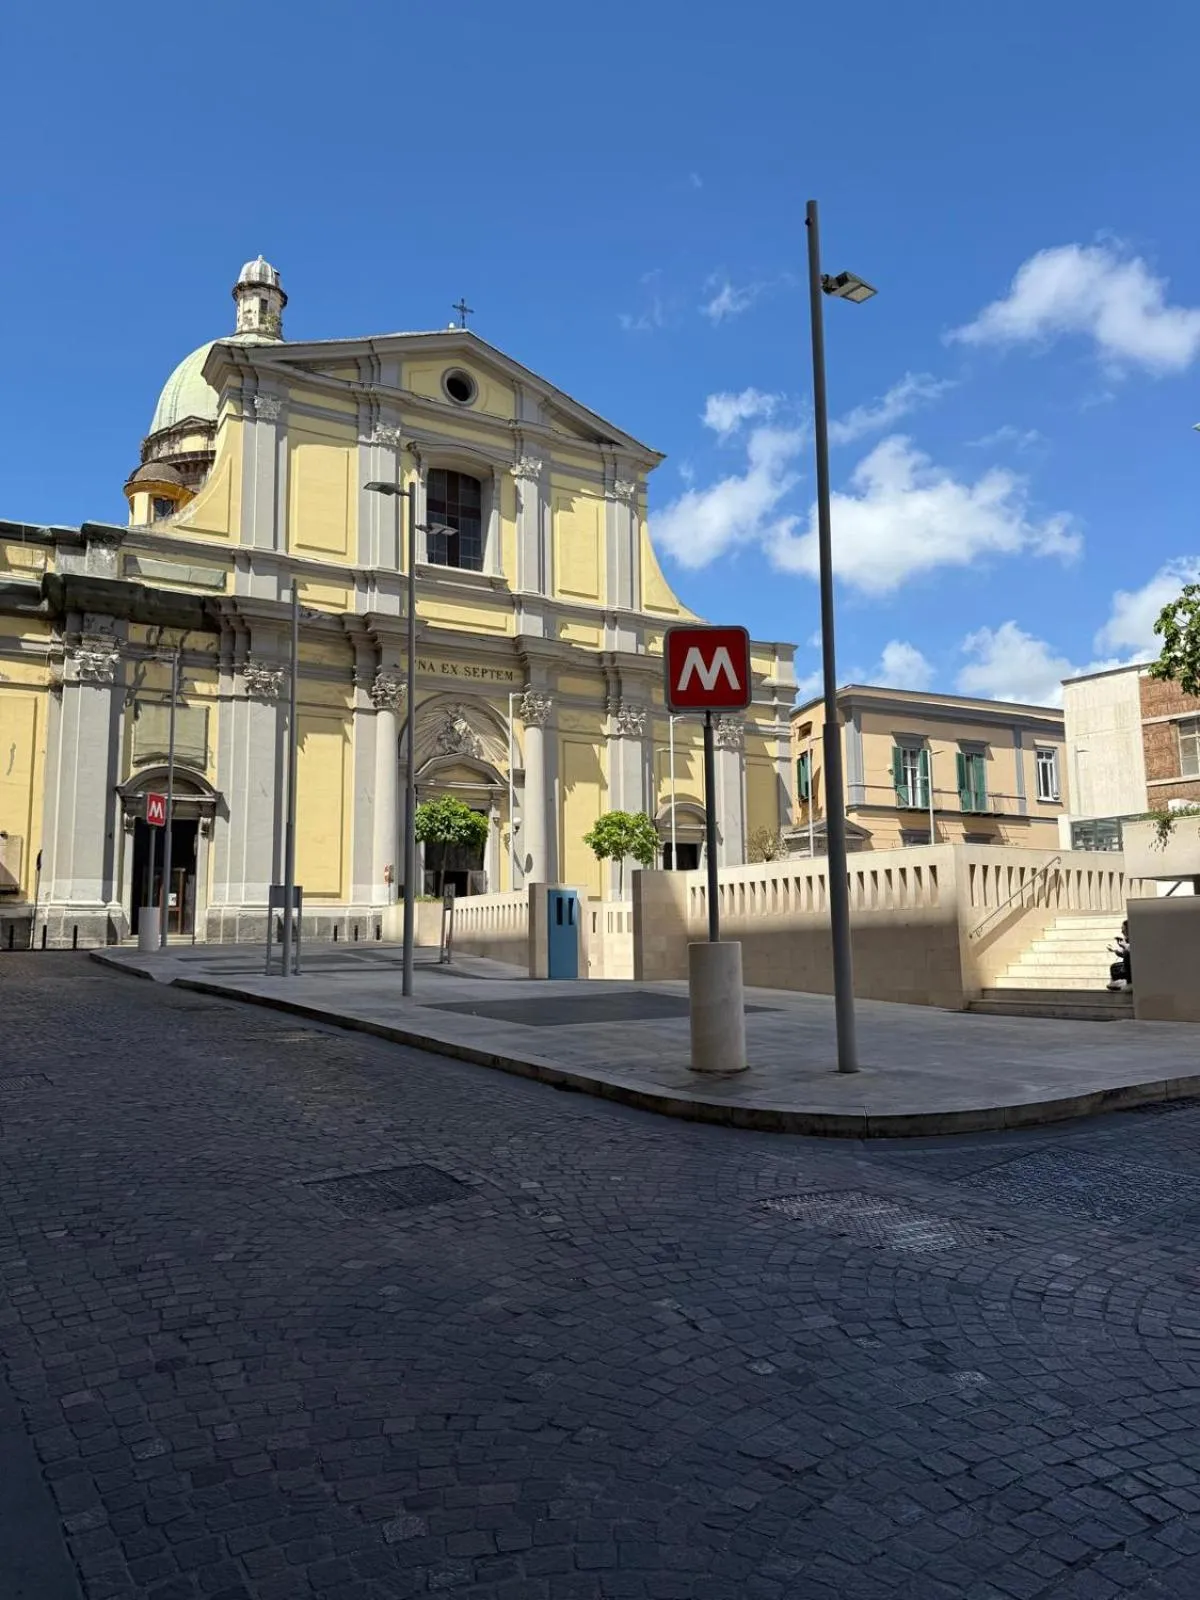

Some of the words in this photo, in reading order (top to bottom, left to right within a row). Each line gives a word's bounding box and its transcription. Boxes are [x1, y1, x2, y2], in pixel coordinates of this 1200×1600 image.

[415, 660, 436, 673] NA
[441, 663, 458, 675] EX
[463, 666, 513, 681] SEPTEM
[677, 647, 741, 691] M
[148, 800, 163, 819] M
